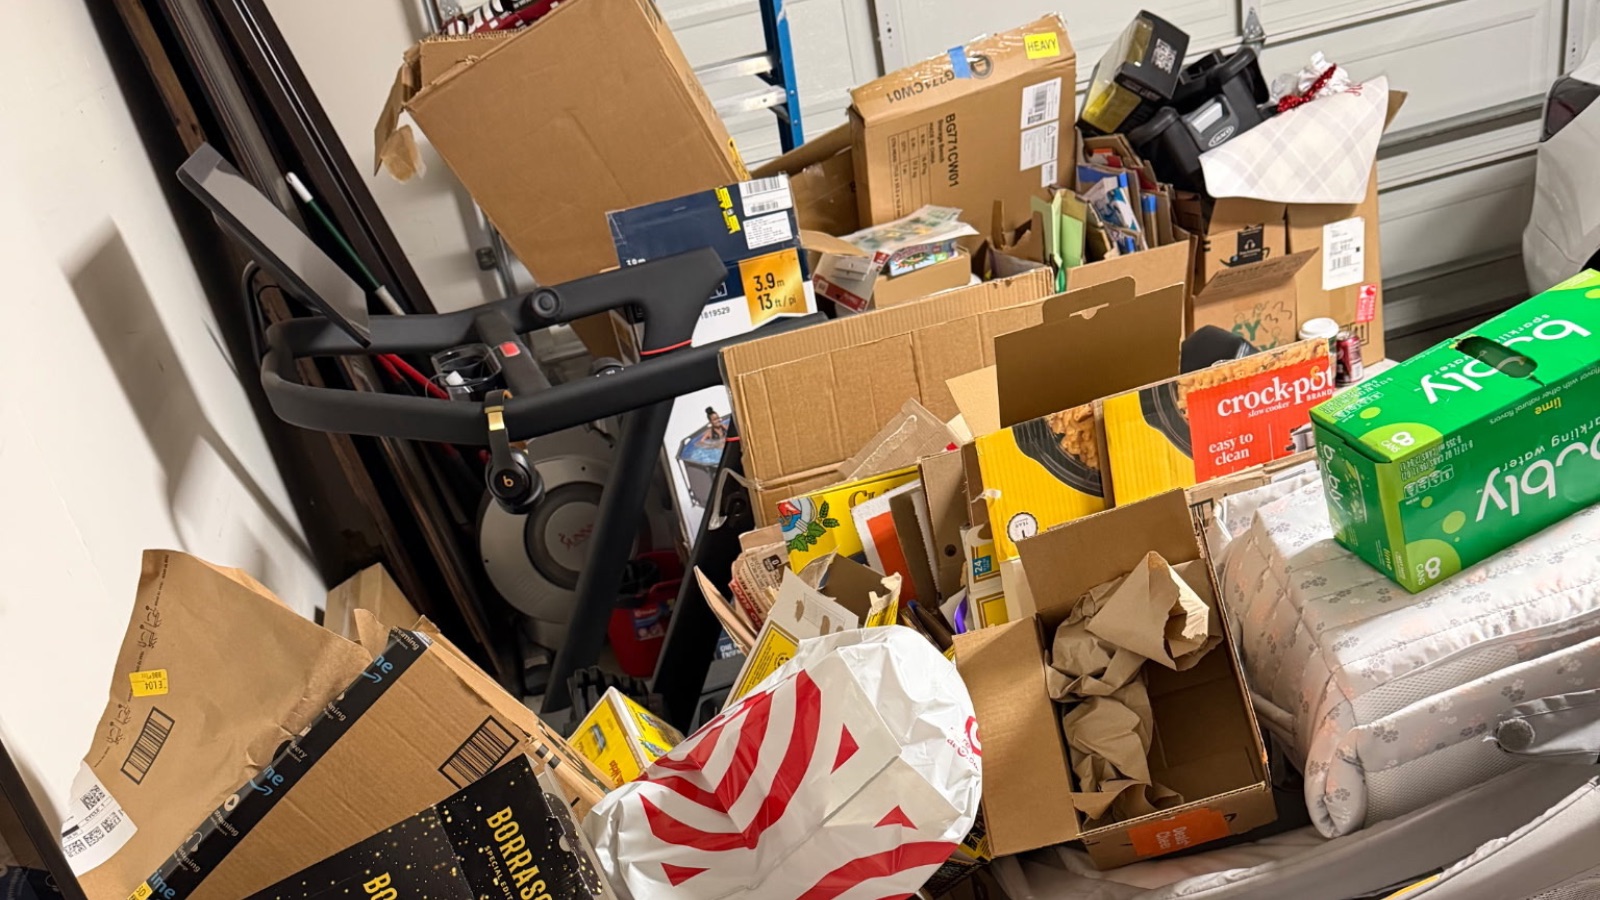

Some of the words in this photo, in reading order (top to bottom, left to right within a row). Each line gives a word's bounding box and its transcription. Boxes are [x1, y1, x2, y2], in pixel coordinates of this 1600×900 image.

[1027, 38, 1057, 52] HEAVY
[886, 69, 955, 104] G771CW01
[945, 113, 959, 188] BG771CW01
[752, 272, 776, 293] 3.9
[777, 278, 785, 288] m
[757, 292, 773, 311] 13
[1306, 389, 1333, 402] BRAND
[1542, 386, 1561, 398] other
[1248, 409, 1265, 418] slow
[1265, 401, 1291, 413] cooker
[1515, 395, 1540, 410] natural
[1534, 397, 1562, 415] lime
[1489, 408, 1515, 424] flavors
[1208, 436, 1237, 454] easy
[1240, 433, 1253, 445] to
[1391, 431, 1416, 447] 8
[1215, 448, 1250, 466] clean
[1503, 445, 1545, 472] water
[975, 560, 983, 574] 24
[1425, 556, 1441, 579] 8
[484, 845, 503, 880] SPECIAL
